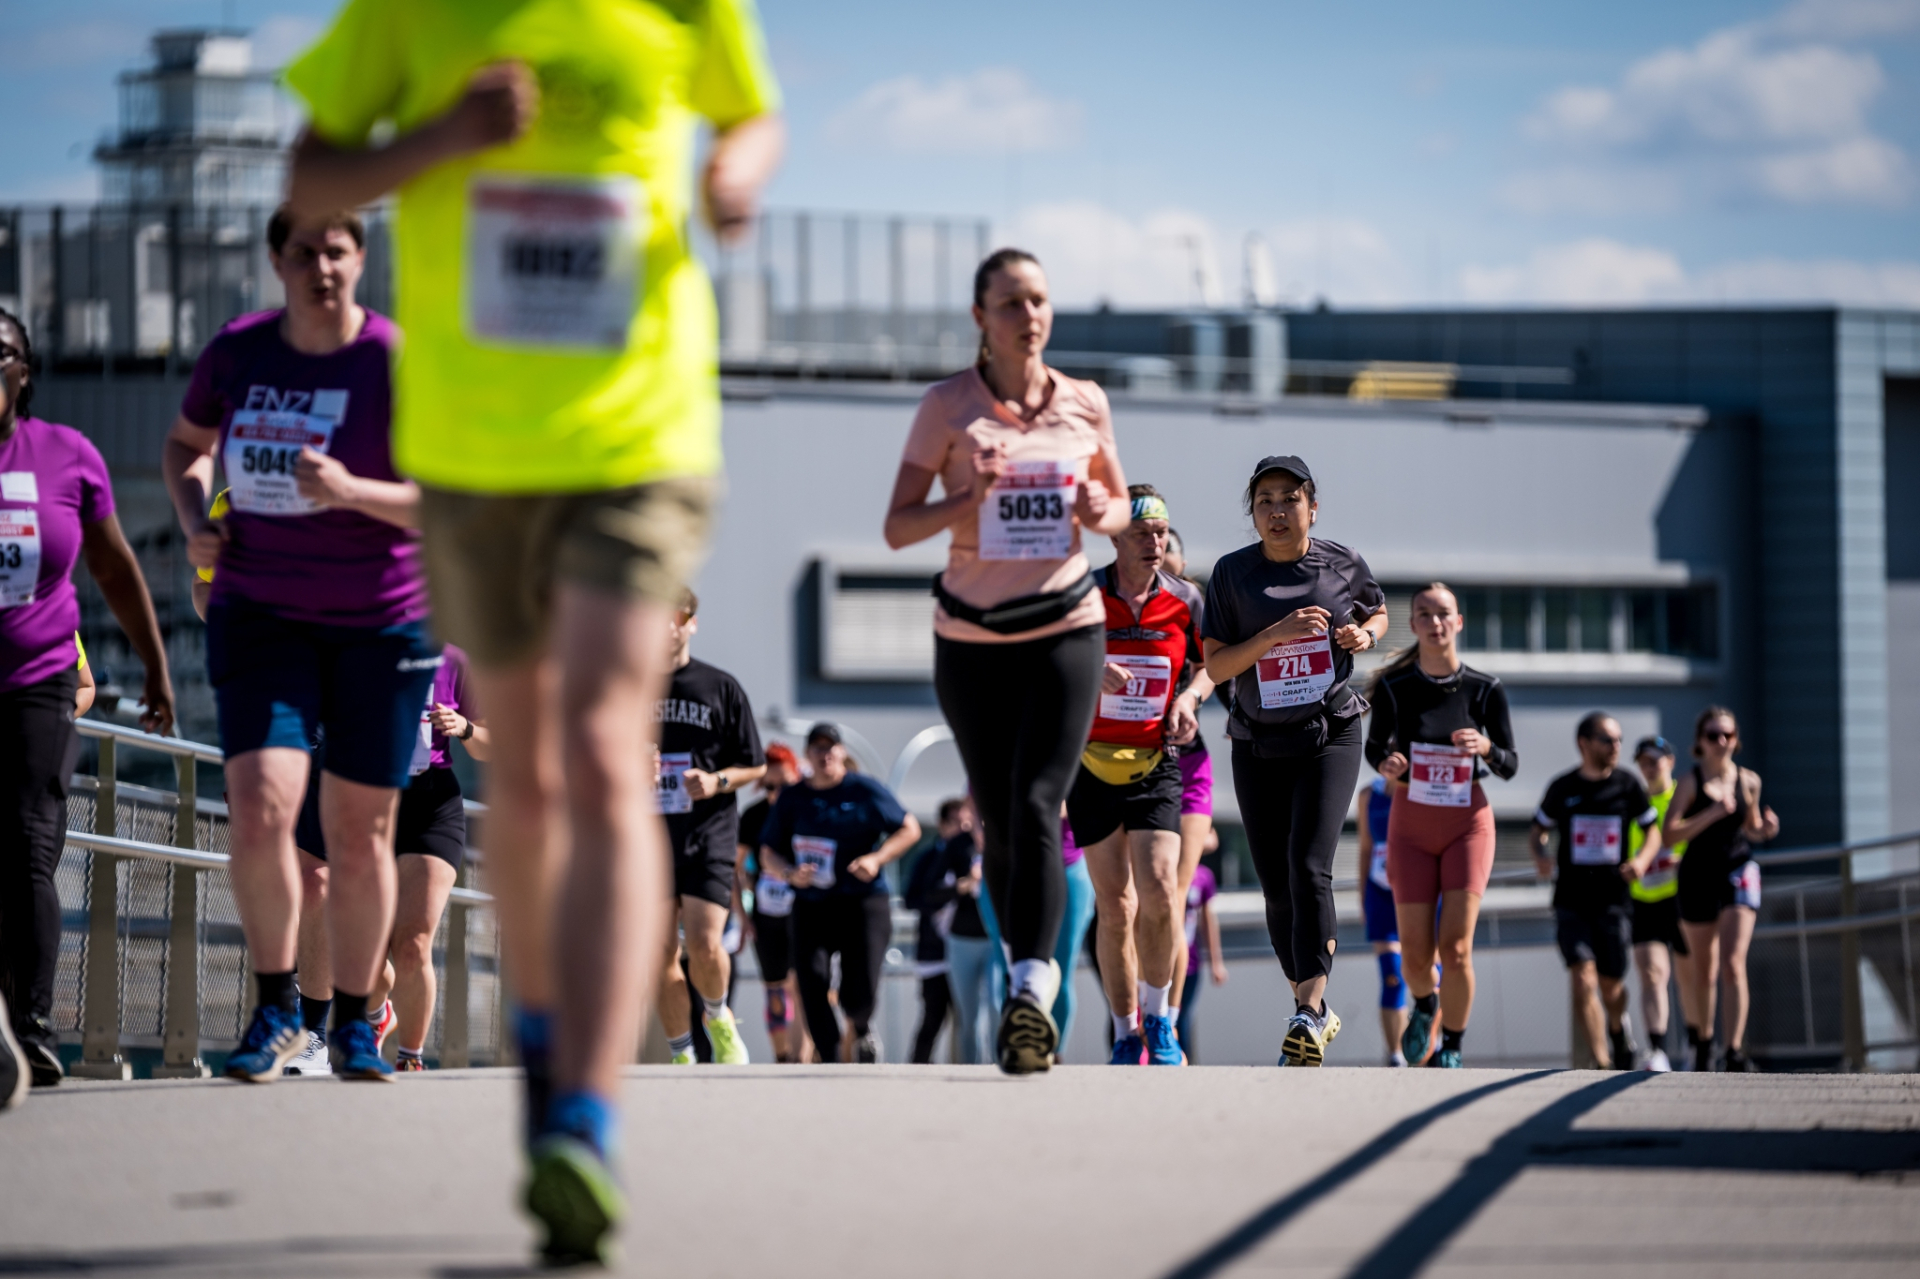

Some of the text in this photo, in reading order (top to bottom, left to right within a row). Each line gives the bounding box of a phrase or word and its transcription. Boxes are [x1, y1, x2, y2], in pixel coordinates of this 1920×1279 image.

[998, 493, 1064, 521] 5033
[1278, 655, 1312, 679] 274
[1126, 678, 1147, 697] 97
[1282, 688, 1308, 696] CRAFT
[1428, 766, 1455, 783] 123
